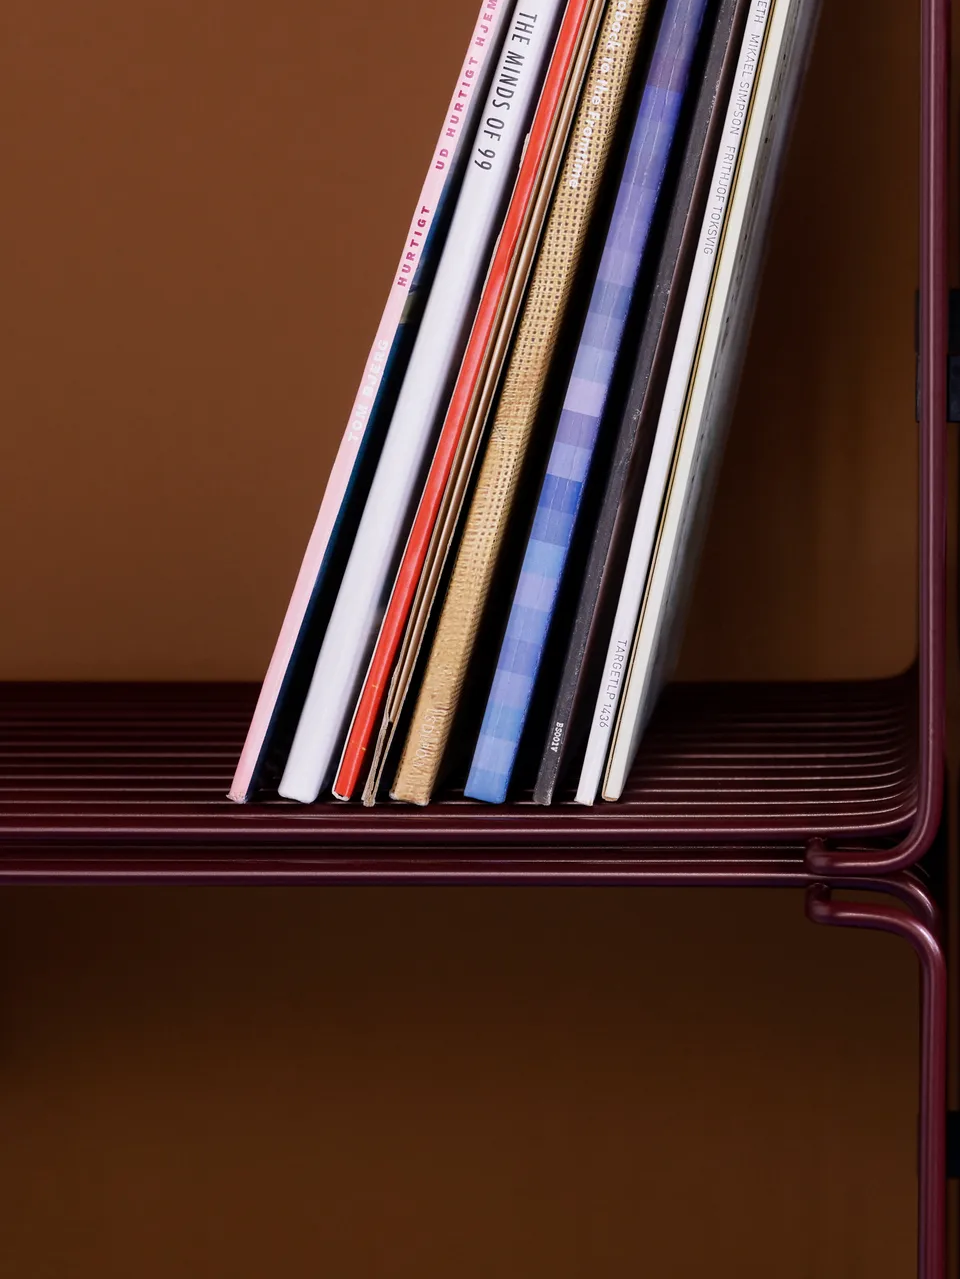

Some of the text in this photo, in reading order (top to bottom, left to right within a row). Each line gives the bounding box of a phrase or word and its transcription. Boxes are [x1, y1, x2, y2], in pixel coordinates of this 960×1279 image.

[474, 12, 538, 172] THE MINDS OF 99
[591, 78, 610, 105] the
[729, 32, 761, 136] MIKAEL SIMPSON
[397, 205, 431, 288] HURTIGT
[434, 146, 450, 171] UD
[446, 56, 479, 139] HURTIGT
[703, 144, 736, 257] FRITHJOF TOKSVIG
[347, 339, 389, 442] TOM BJERG
[599, 703, 612, 728] 1436
